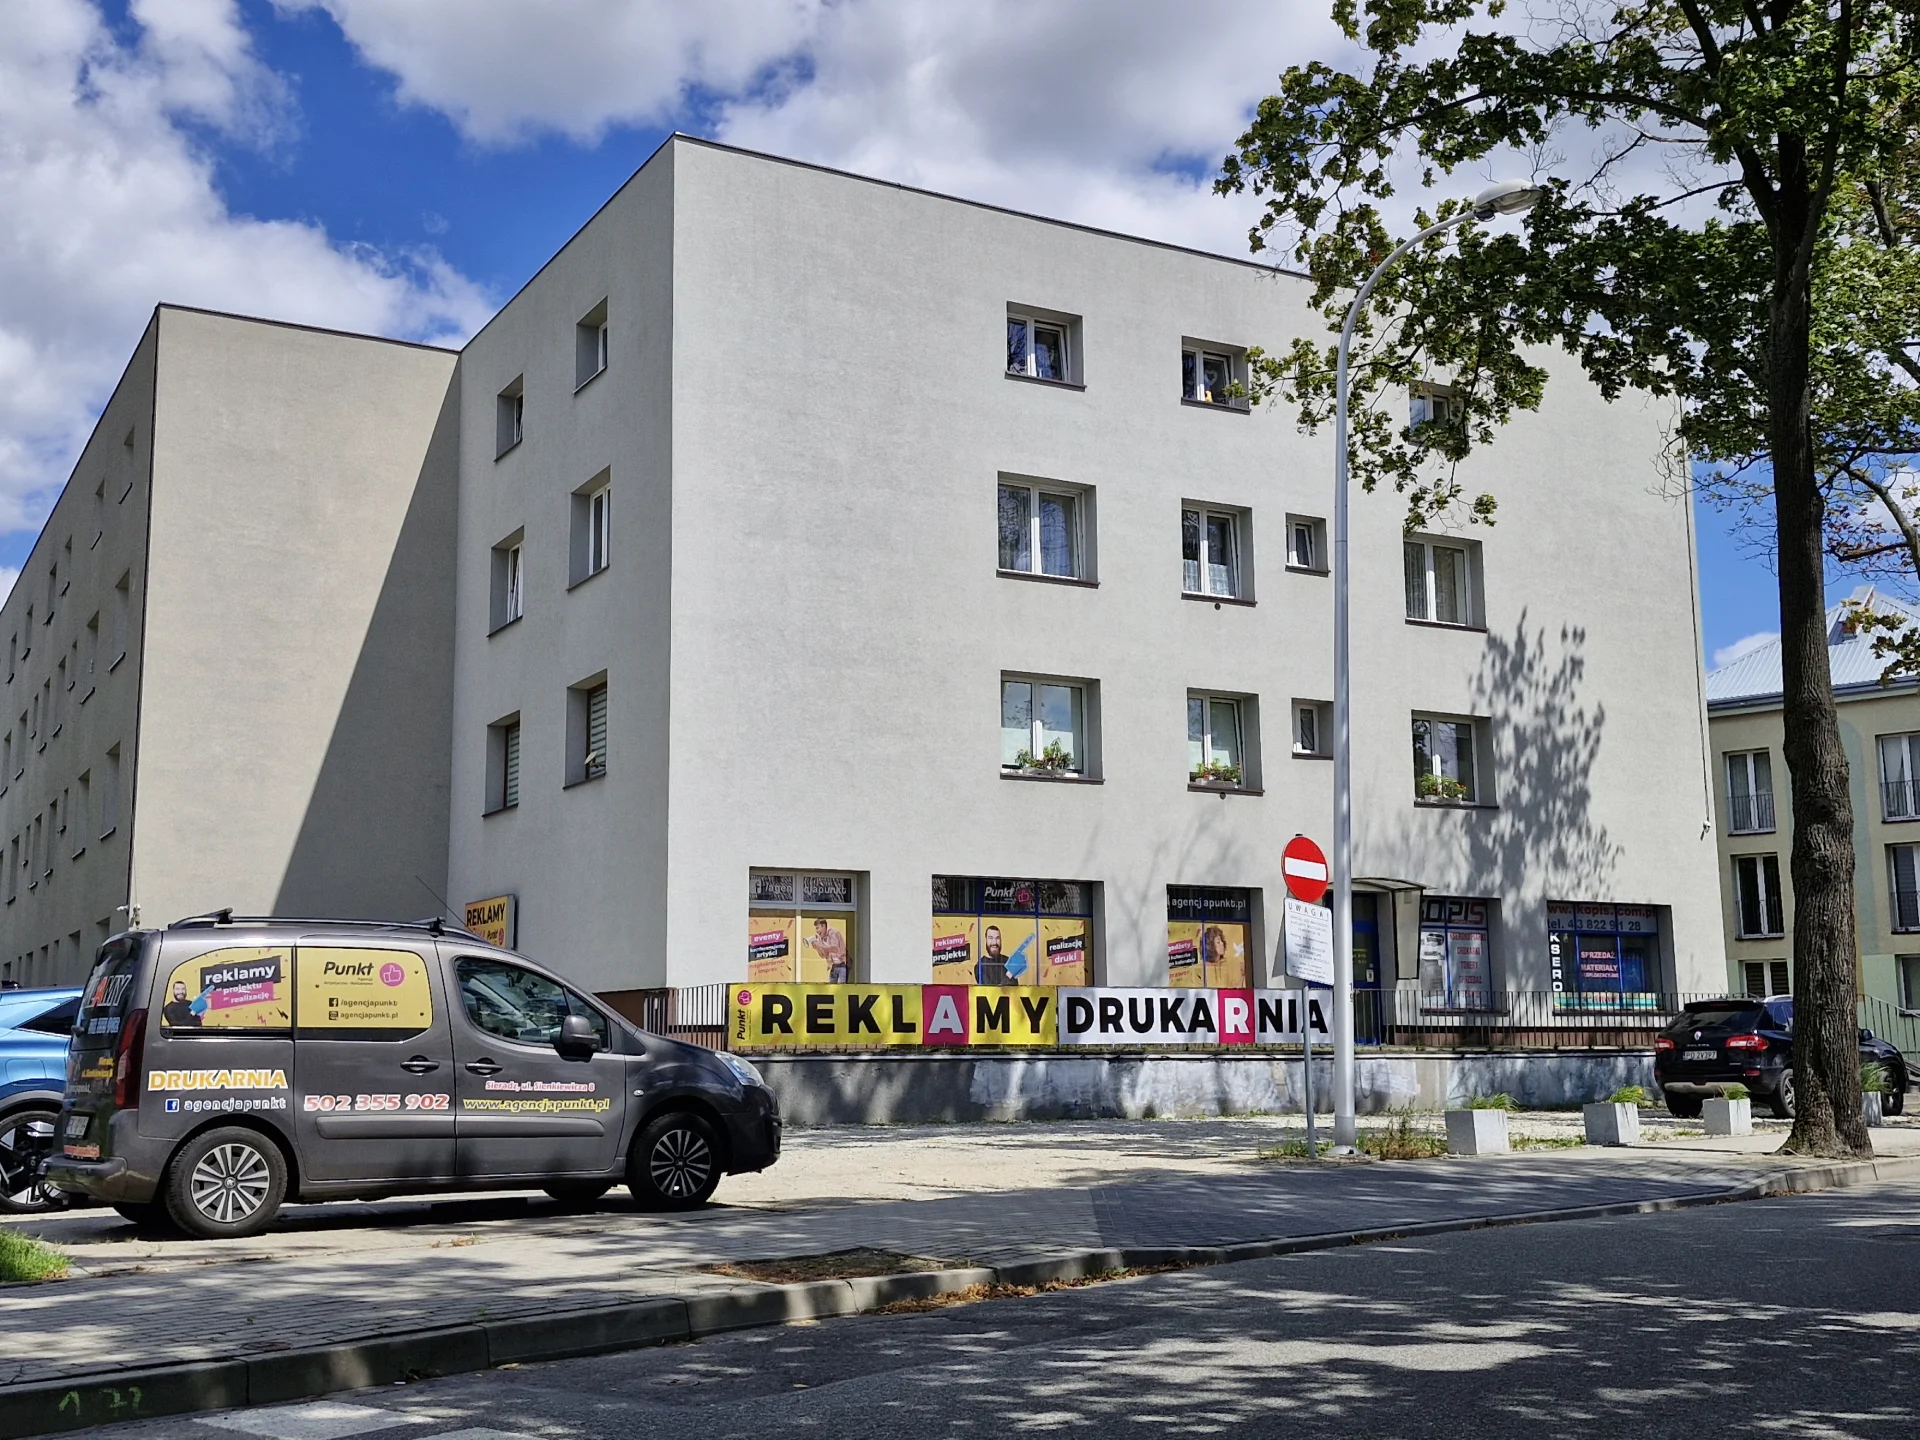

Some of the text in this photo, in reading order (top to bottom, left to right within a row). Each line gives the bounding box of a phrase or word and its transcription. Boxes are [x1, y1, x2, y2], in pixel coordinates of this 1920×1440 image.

[984, 886, 1014, 898] Punkt
[466, 902, 506, 927] REKLAMY
[1421, 900, 1485, 925] OPIS
[1586, 920, 1606, 930] 822
[1628, 921, 1642, 931] 28
[934, 936, 964, 948] reklamy
[932, 949, 967, 963] projektu
[1054, 954, 1078, 965] druki
[205, 965, 276, 984] reklamy
[323, 961, 374, 976] Punkt
[340, 1011, 399, 1020] agencjapunkt.pl
[761, 994, 1049, 1034] REKLAMY
[1066, 997, 1328, 1034] DRUKARNIA
[737, 1008, 747, 1041] Punkt
[148, 1069, 288, 1091] DRUKARNIA
[485, 1081, 520, 1092] Sieradz,
[533, 1082, 588, 1091] Sienkiewicza
[184, 1097, 286, 1112] agencjapunkt
[304, 1093, 450, 1111] 502 355 902
[463, 1099, 610, 1112] www.agencjapunkt.pl
